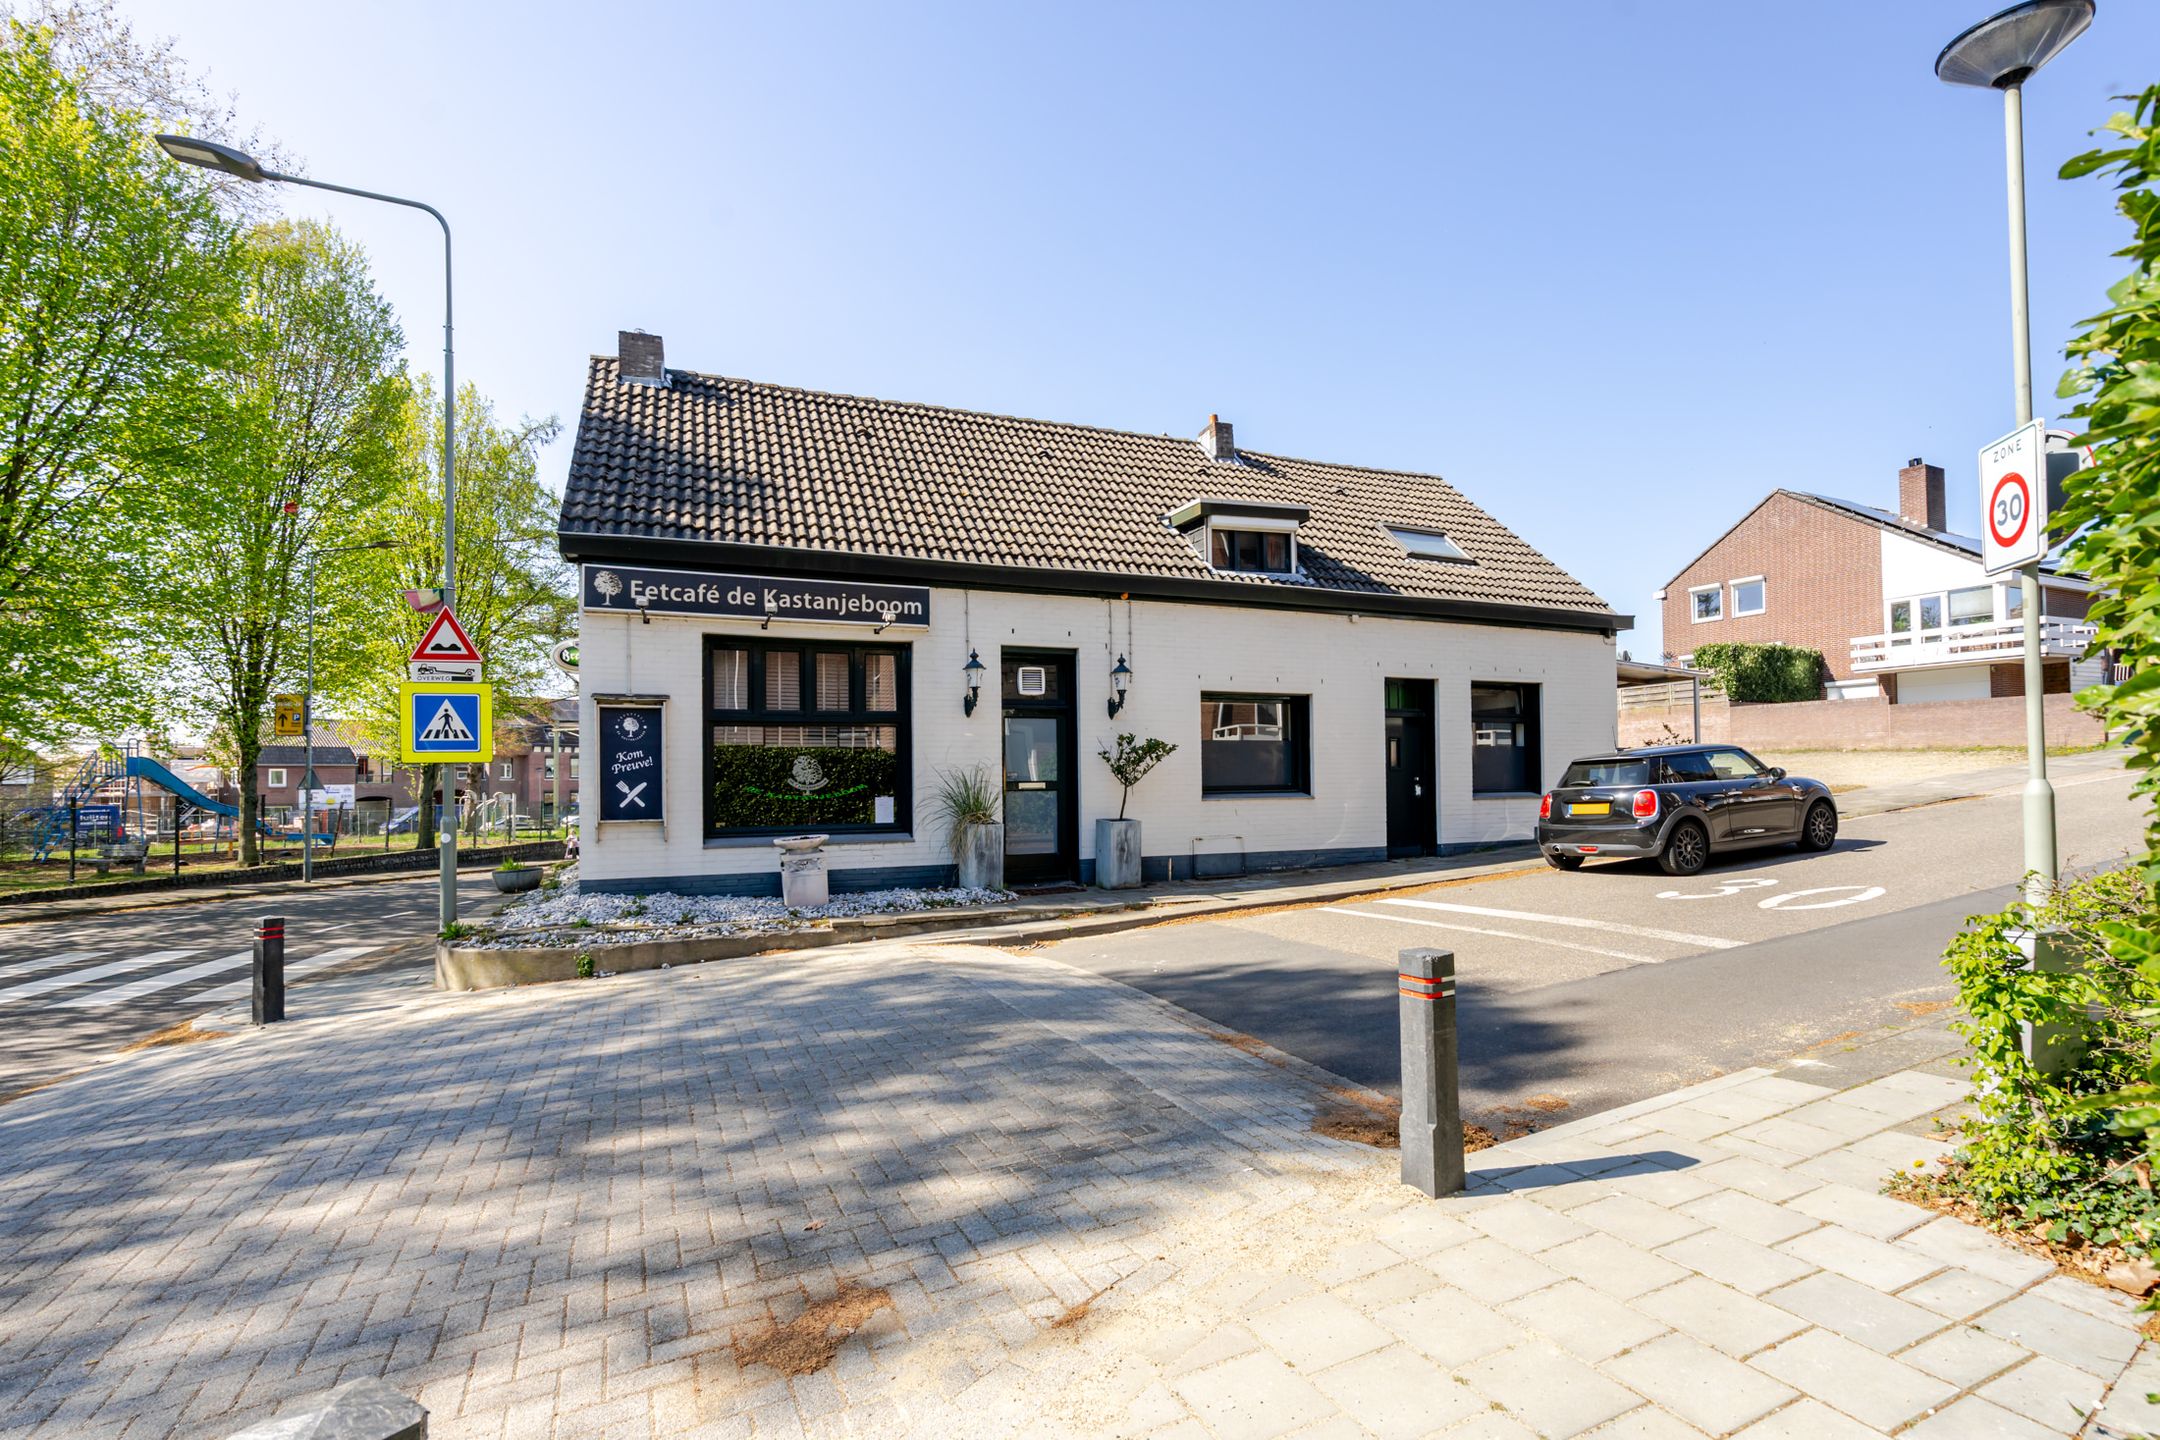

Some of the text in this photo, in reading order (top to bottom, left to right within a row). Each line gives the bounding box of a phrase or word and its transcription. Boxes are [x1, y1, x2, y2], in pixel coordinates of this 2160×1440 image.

[1993, 439, 2022, 463] ZONE
[1997, 493, 2022, 526] 30
[630, 579, 922, 617] Eetcafé de Kastanjeboom
[611, 755, 653, 774] Preuve!
[616, 750, 644, 763] Kom
[1655, 878, 1887, 910] 30
